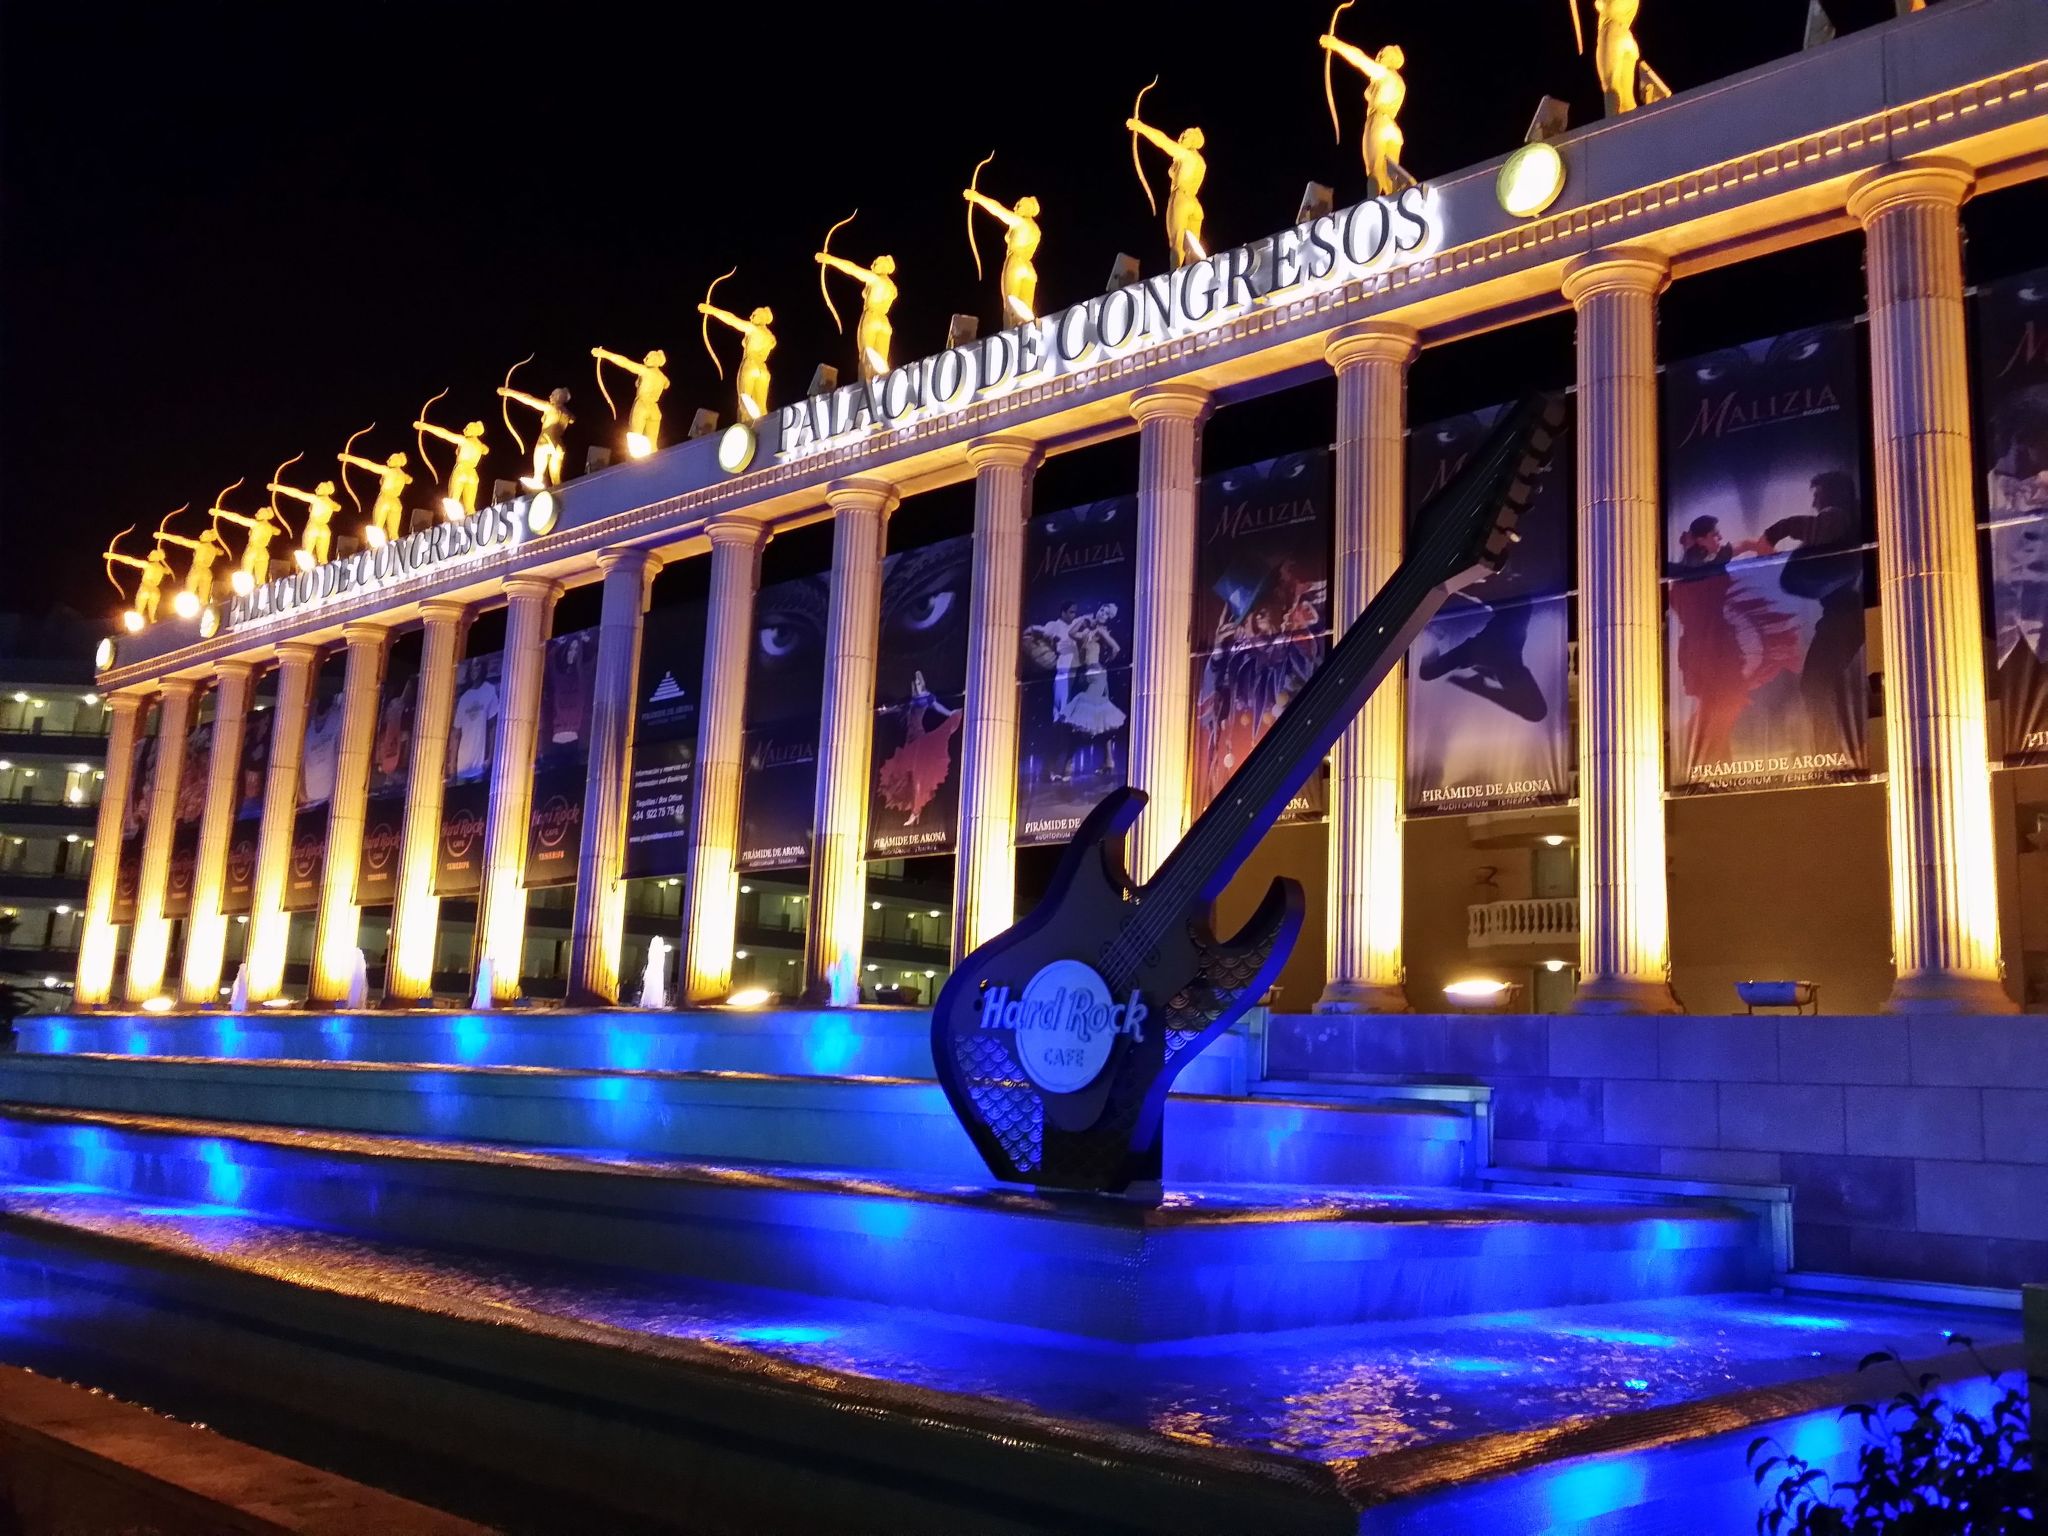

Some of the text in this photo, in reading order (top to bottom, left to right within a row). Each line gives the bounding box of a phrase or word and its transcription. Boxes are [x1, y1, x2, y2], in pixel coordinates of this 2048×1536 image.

[774, 186, 1430, 455] PALACIO DE CONGRESOS
[1679, 384, 1837, 448] MALIZIA
[1208, 499, 1315, 544] MALIZIA
[228, 501, 515, 628] PALACIO DE CONGRESOS
[1032, 542, 1124, 584] MALIZIA
[1690, 752, 1849, 780] PIRÁMIDE DE ARONA
[1708, 776, 1772, 789] AUDITORIUM
[1422, 779, 1551, 802] PIRÁMIDE DE ARONA
[920, 831, 946, 844] ARONA
[1024, 817, 1081, 834] PIRÁMIDE DE
[980, 986, 1149, 1044] Hard Rock
[1044, 1048, 1085, 1068] CAFE
